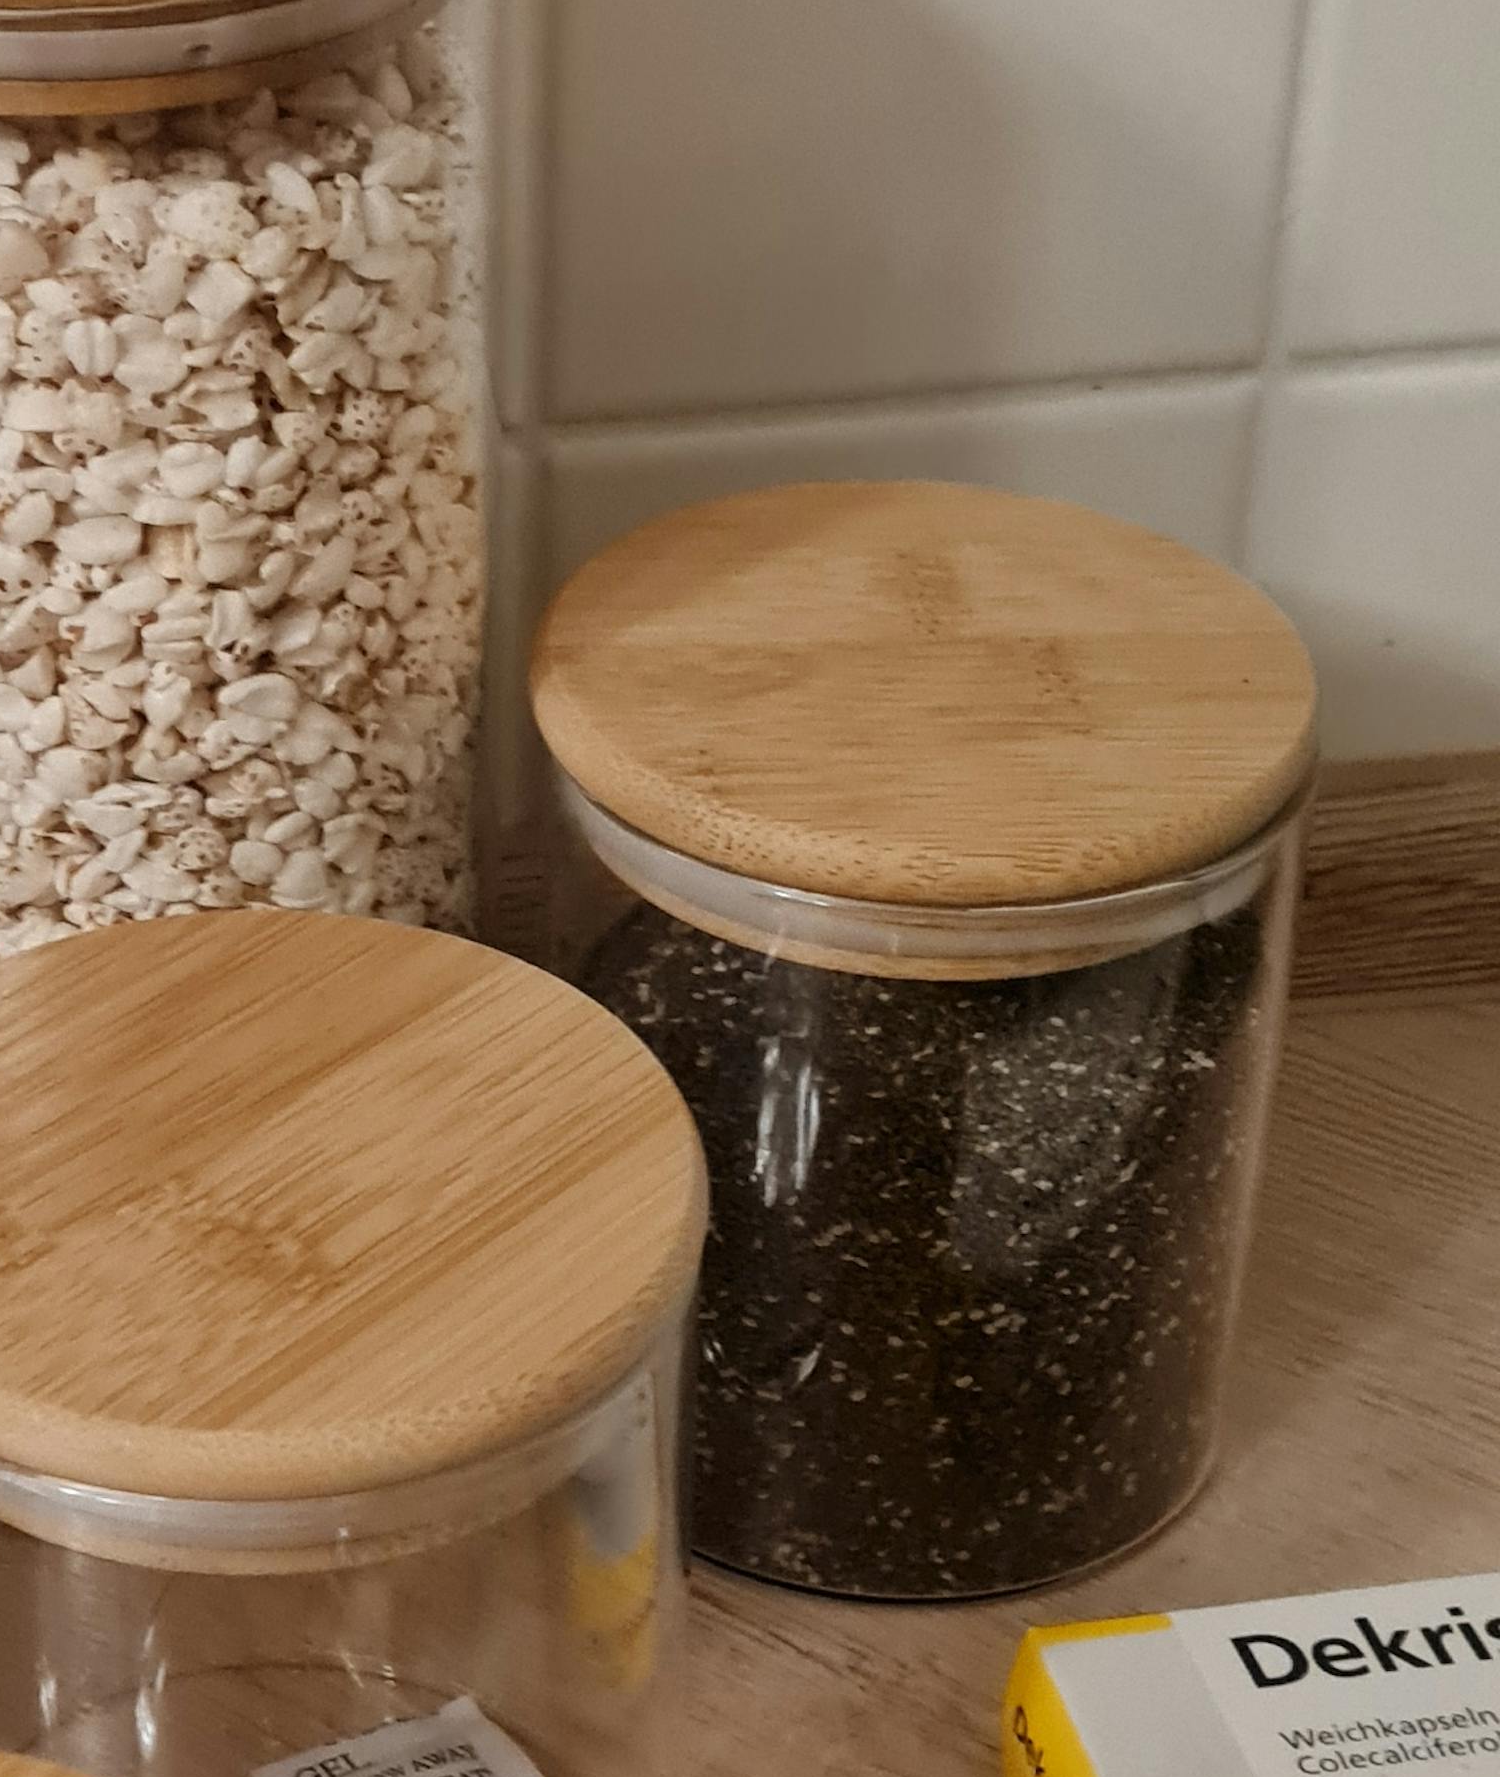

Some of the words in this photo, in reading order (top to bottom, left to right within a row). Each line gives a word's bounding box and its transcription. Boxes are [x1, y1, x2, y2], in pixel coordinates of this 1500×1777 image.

[1277, 1706, 1500, 1752] Weichkapseln
[411, 1743, 478, 1773] AWAY
[1298, 1728, 1500, 1777] Colecalcifero
